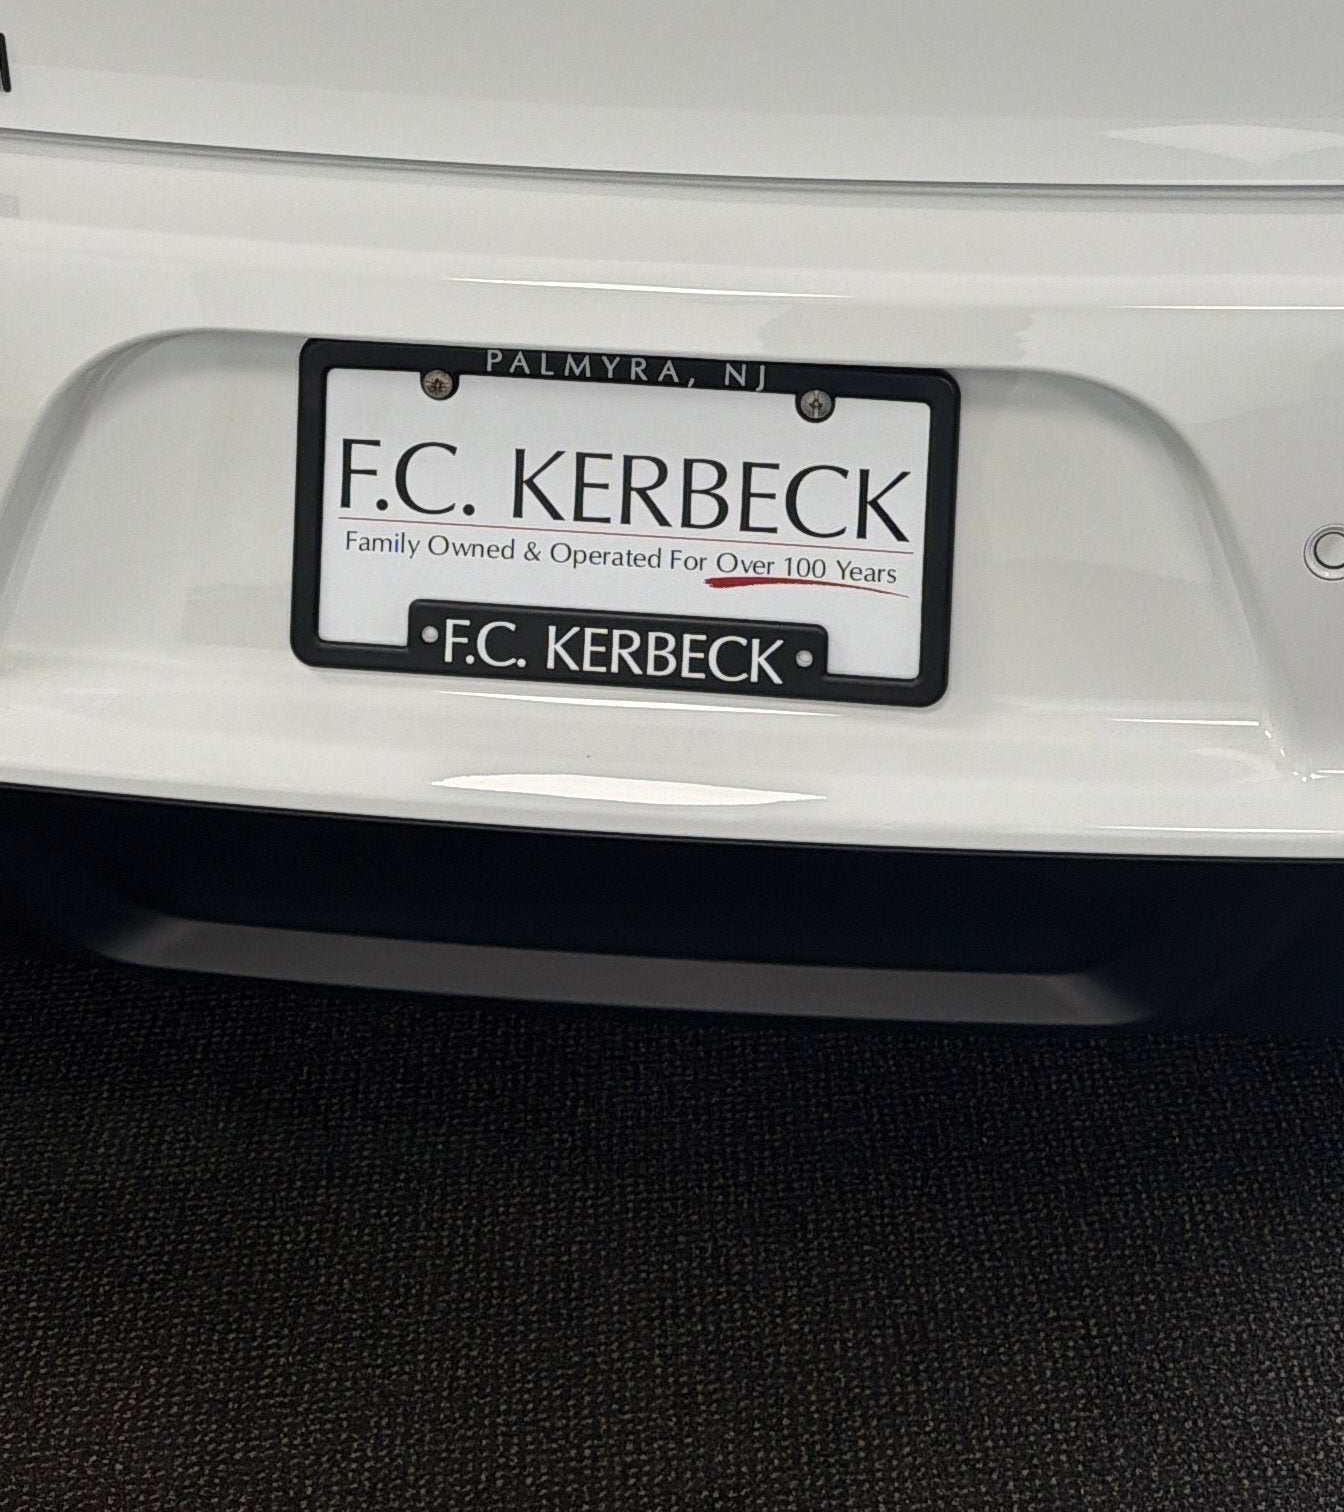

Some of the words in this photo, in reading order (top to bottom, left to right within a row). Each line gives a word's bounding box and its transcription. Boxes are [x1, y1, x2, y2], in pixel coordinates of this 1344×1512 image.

[485, 349, 695, 388] PALMYRA,
[724, 362, 767, 392] NJ
[340, 437, 476, 516] F.C.
[512, 448, 912, 543] KERBECK
[345, 530, 421, 559] Family
[428, 534, 515, 561] Owned
[523, 541, 542, 562] &
[550, 542, 662, 570] Operated
[670, 549, 708, 572] For
[716, 552, 775, 576] Over
[783, 556, 826, 579] 100
[836, 559, 898, 585] Years
[444, 617, 527, 669] F.C.
[546, 624, 785, 685] KERBECK
